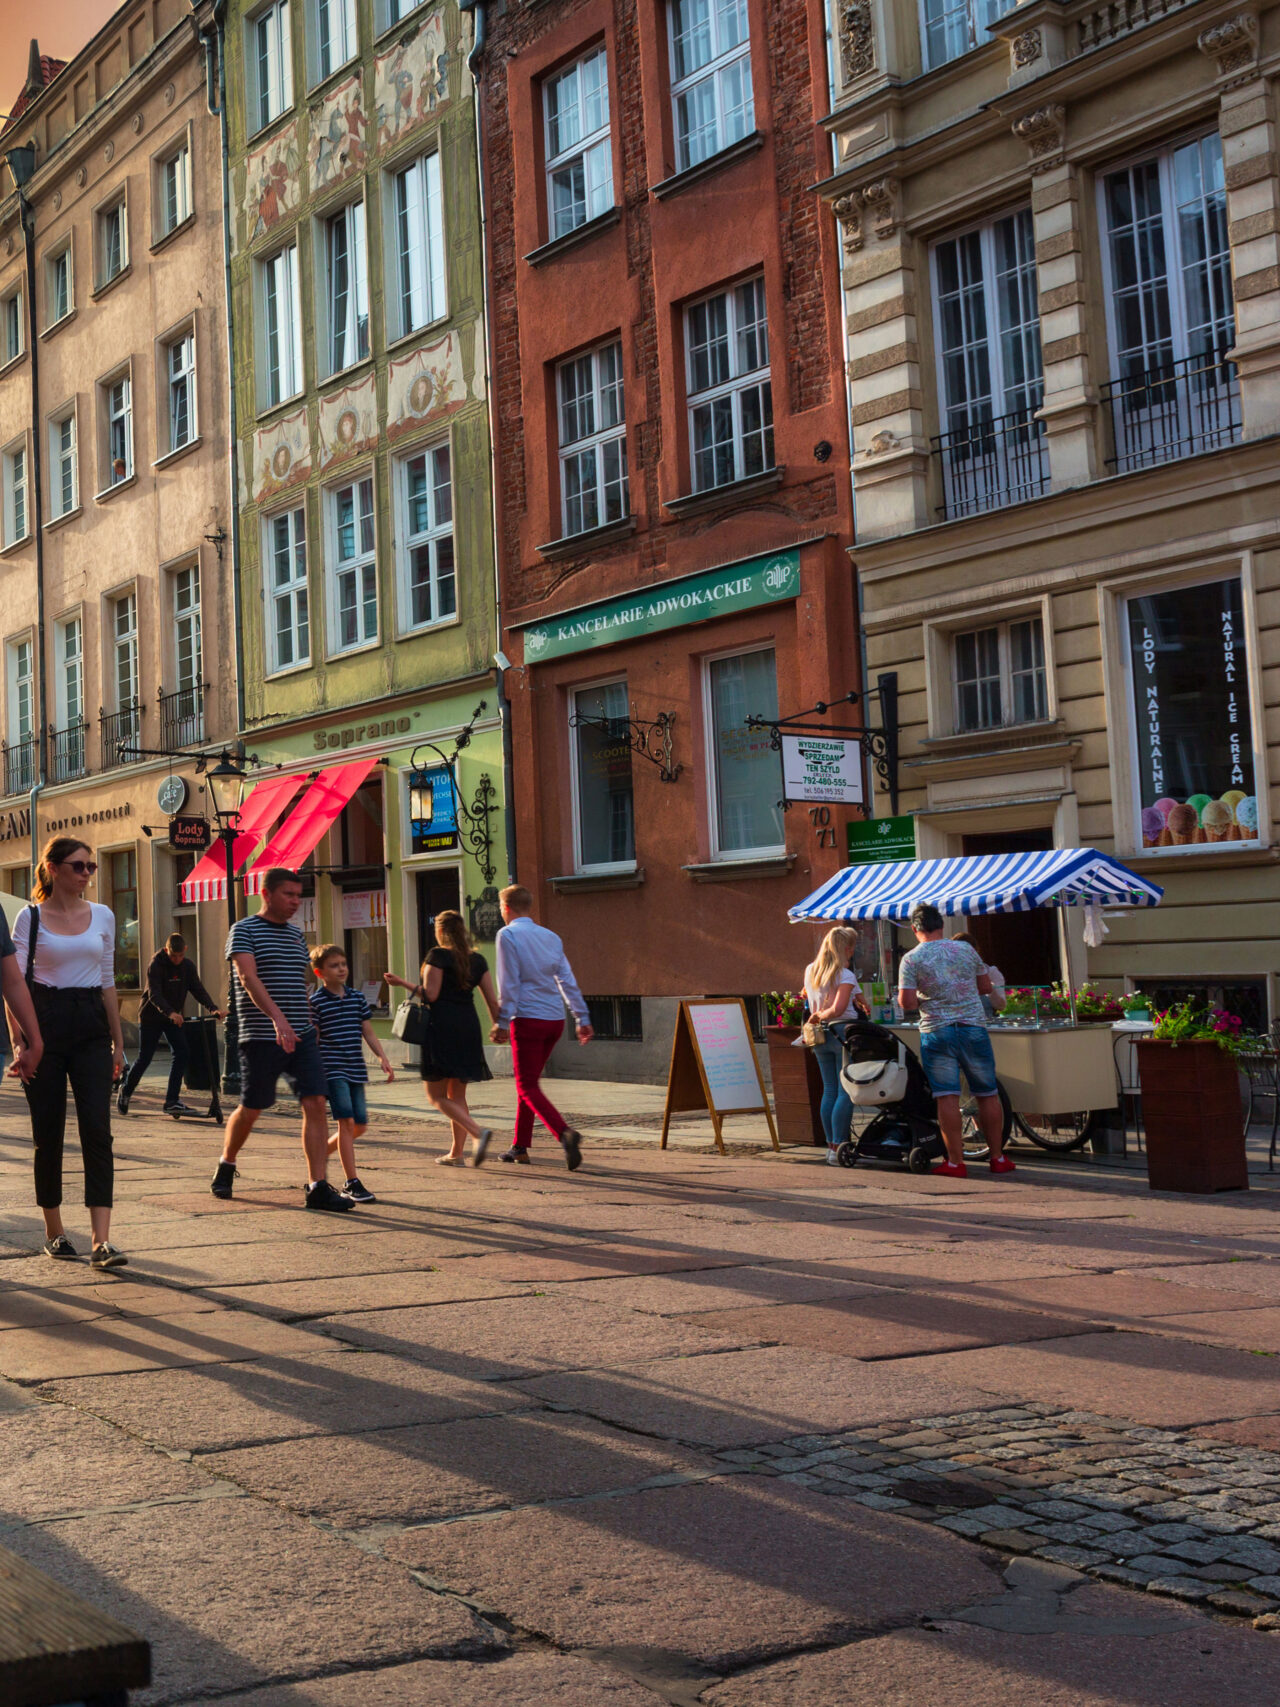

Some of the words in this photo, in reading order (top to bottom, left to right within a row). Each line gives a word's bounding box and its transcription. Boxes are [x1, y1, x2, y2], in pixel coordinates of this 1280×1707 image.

[557, 606, 645, 641] KANCELARIE
[646, 576, 753, 618] ADWOKACKIE
[1142, 627, 1156, 674] LODY
[1221, 611, 1236, 682] NATURAL
[1227, 692, 1238, 723] ICE
[313, 715, 412, 750] Soprano
[1146, 686, 1164, 793] NATURALNE
[592, 746, 630, 760] SCOOTE
[804, 752, 841, 762] SPRZEDAM
[1230, 733, 1243, 784] CREAM
[802, 776, 847, 786] 792-480-555
[805, 764, 819, 772] TEN
[820, 766, 840, 774] SZYLD
[46, 818, 69, 832] LODY
[71, 815, 84, 828] OD
[86, 801, 131, 825] POKOLEŃ
[177, 822, 204, 837] Lody
[808, 806, 830, 827] 70
[174, 834, 206, 846] Soprano
[815, 826, 837, 848] 71
